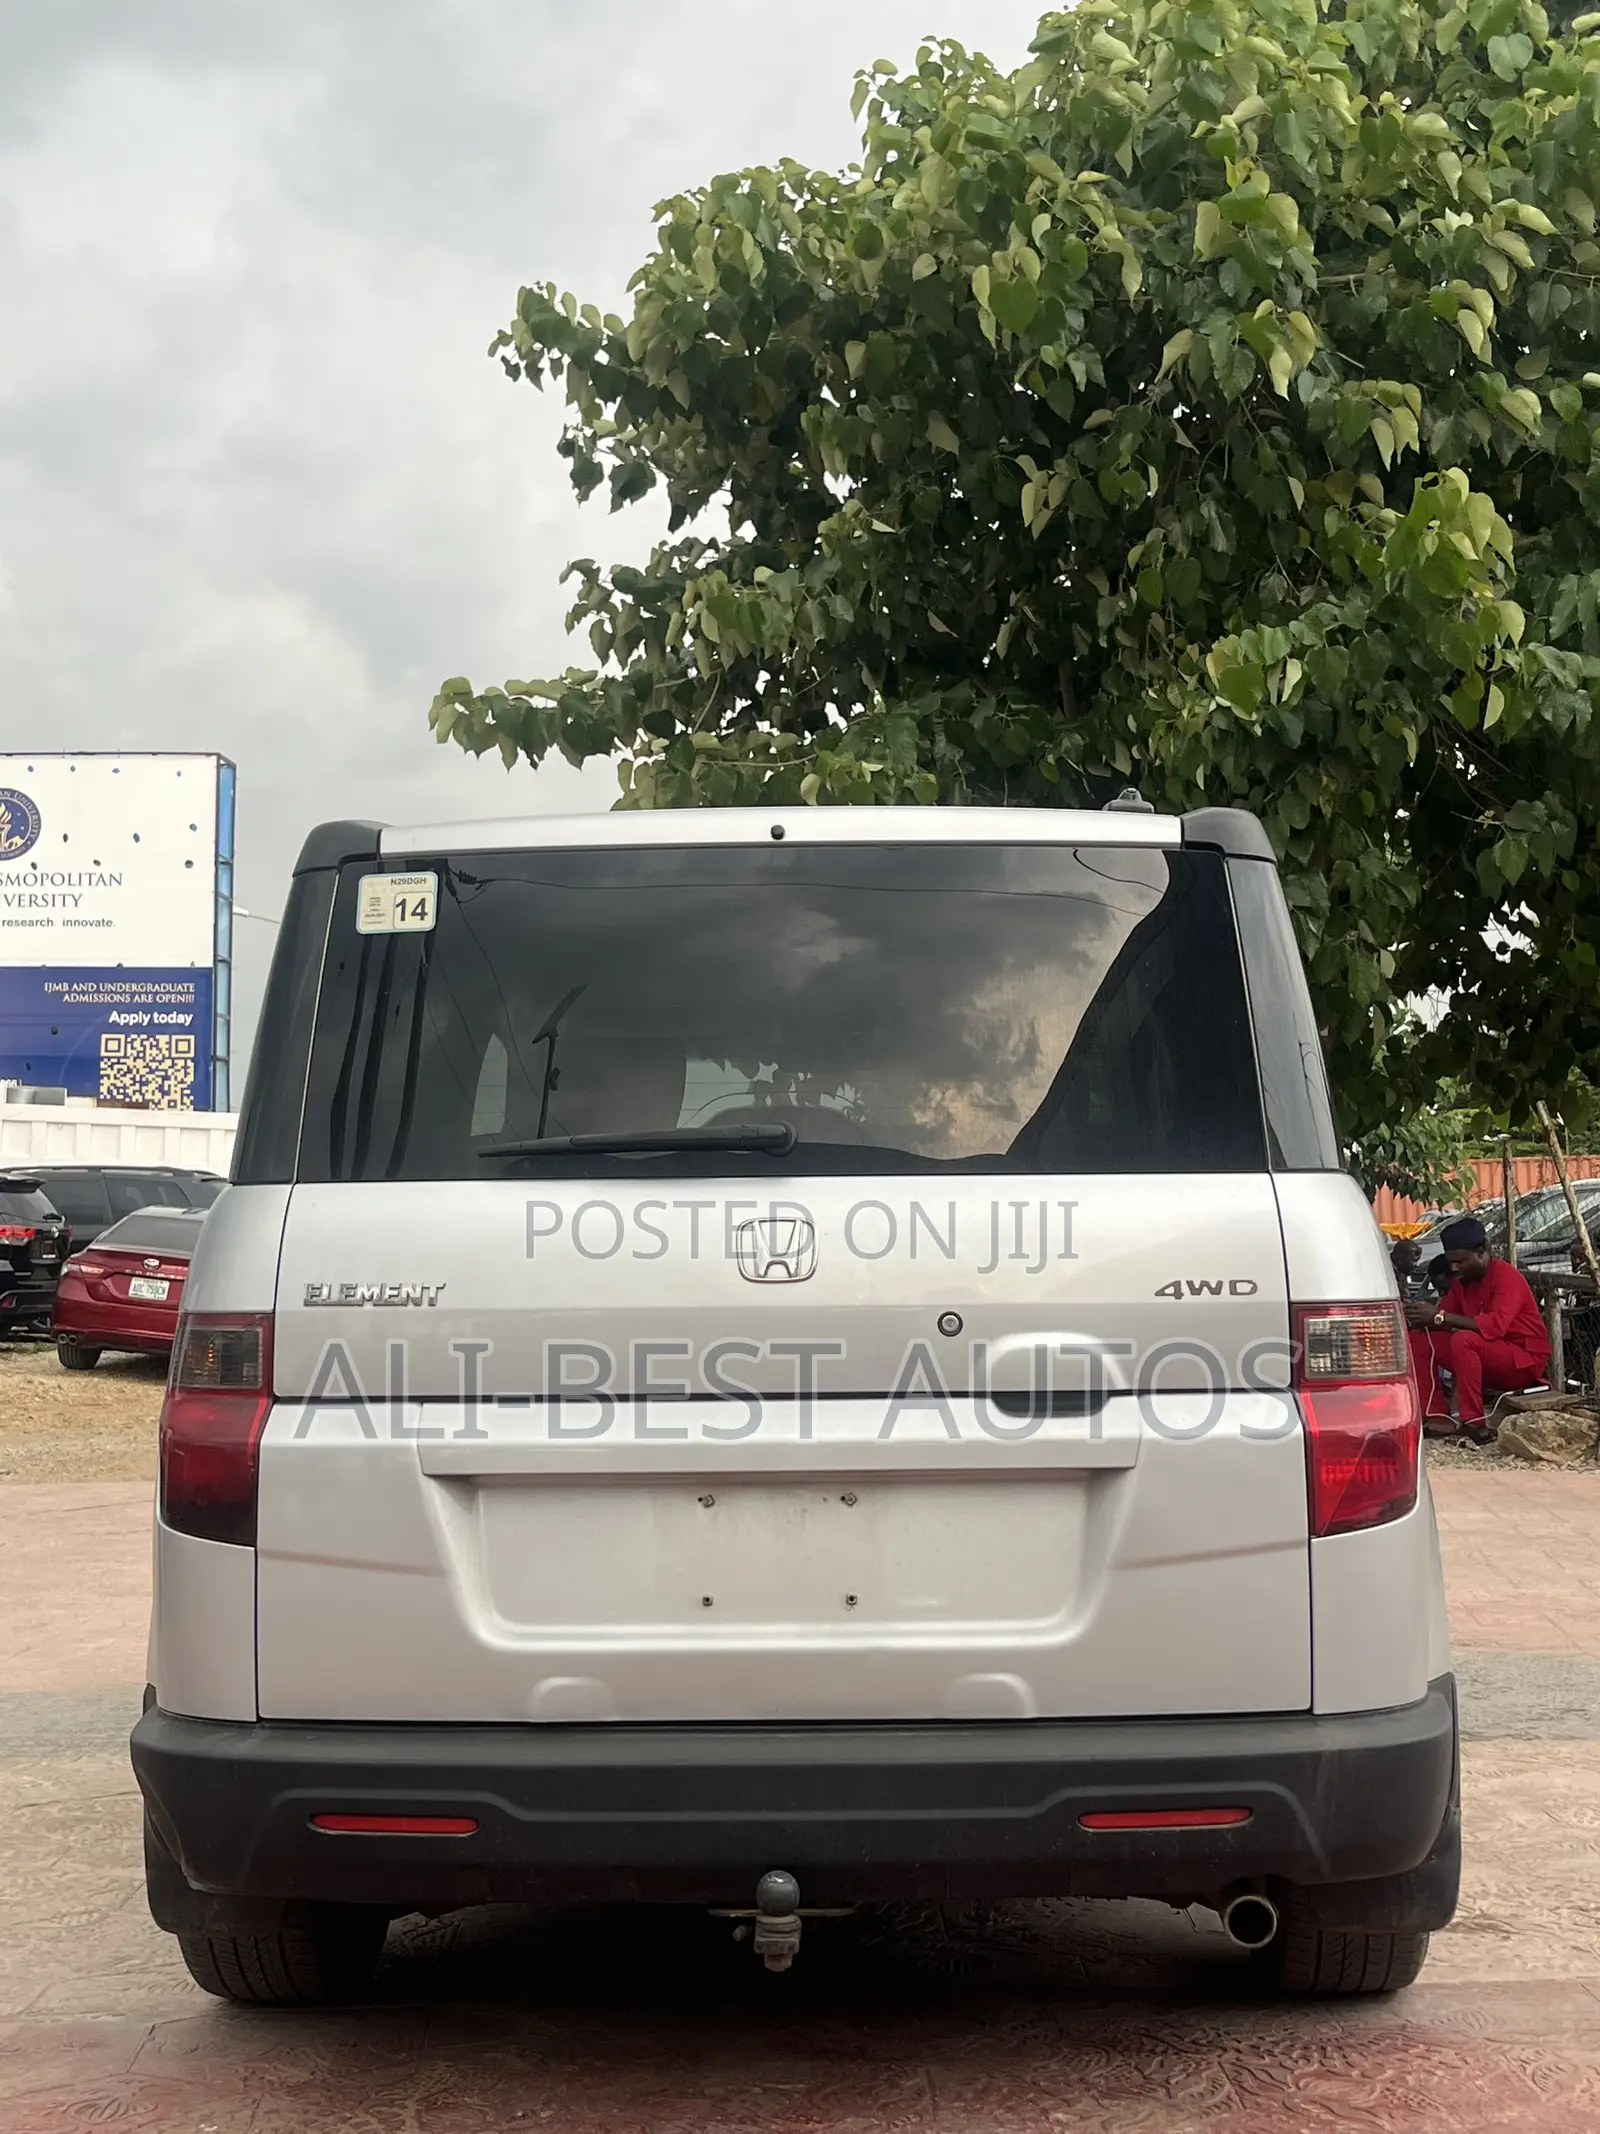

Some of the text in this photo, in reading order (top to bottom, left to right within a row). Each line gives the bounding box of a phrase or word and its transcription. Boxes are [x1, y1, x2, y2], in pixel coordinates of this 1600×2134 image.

[390, 876, 427, 886] N29DGH
[395, 897, 429, 922] 14
[44, 982, 195, 993] IJMB AND UNDERGRADUATE
[62, 993, 195, 1004] ADMISSIONS ARE OPEN!!!
[108, 1010, 194, 1027] Apply today
[303, 1282, 447, 1307] ELEMENT
[1154, 1279, 1258, 1300] 4WD
